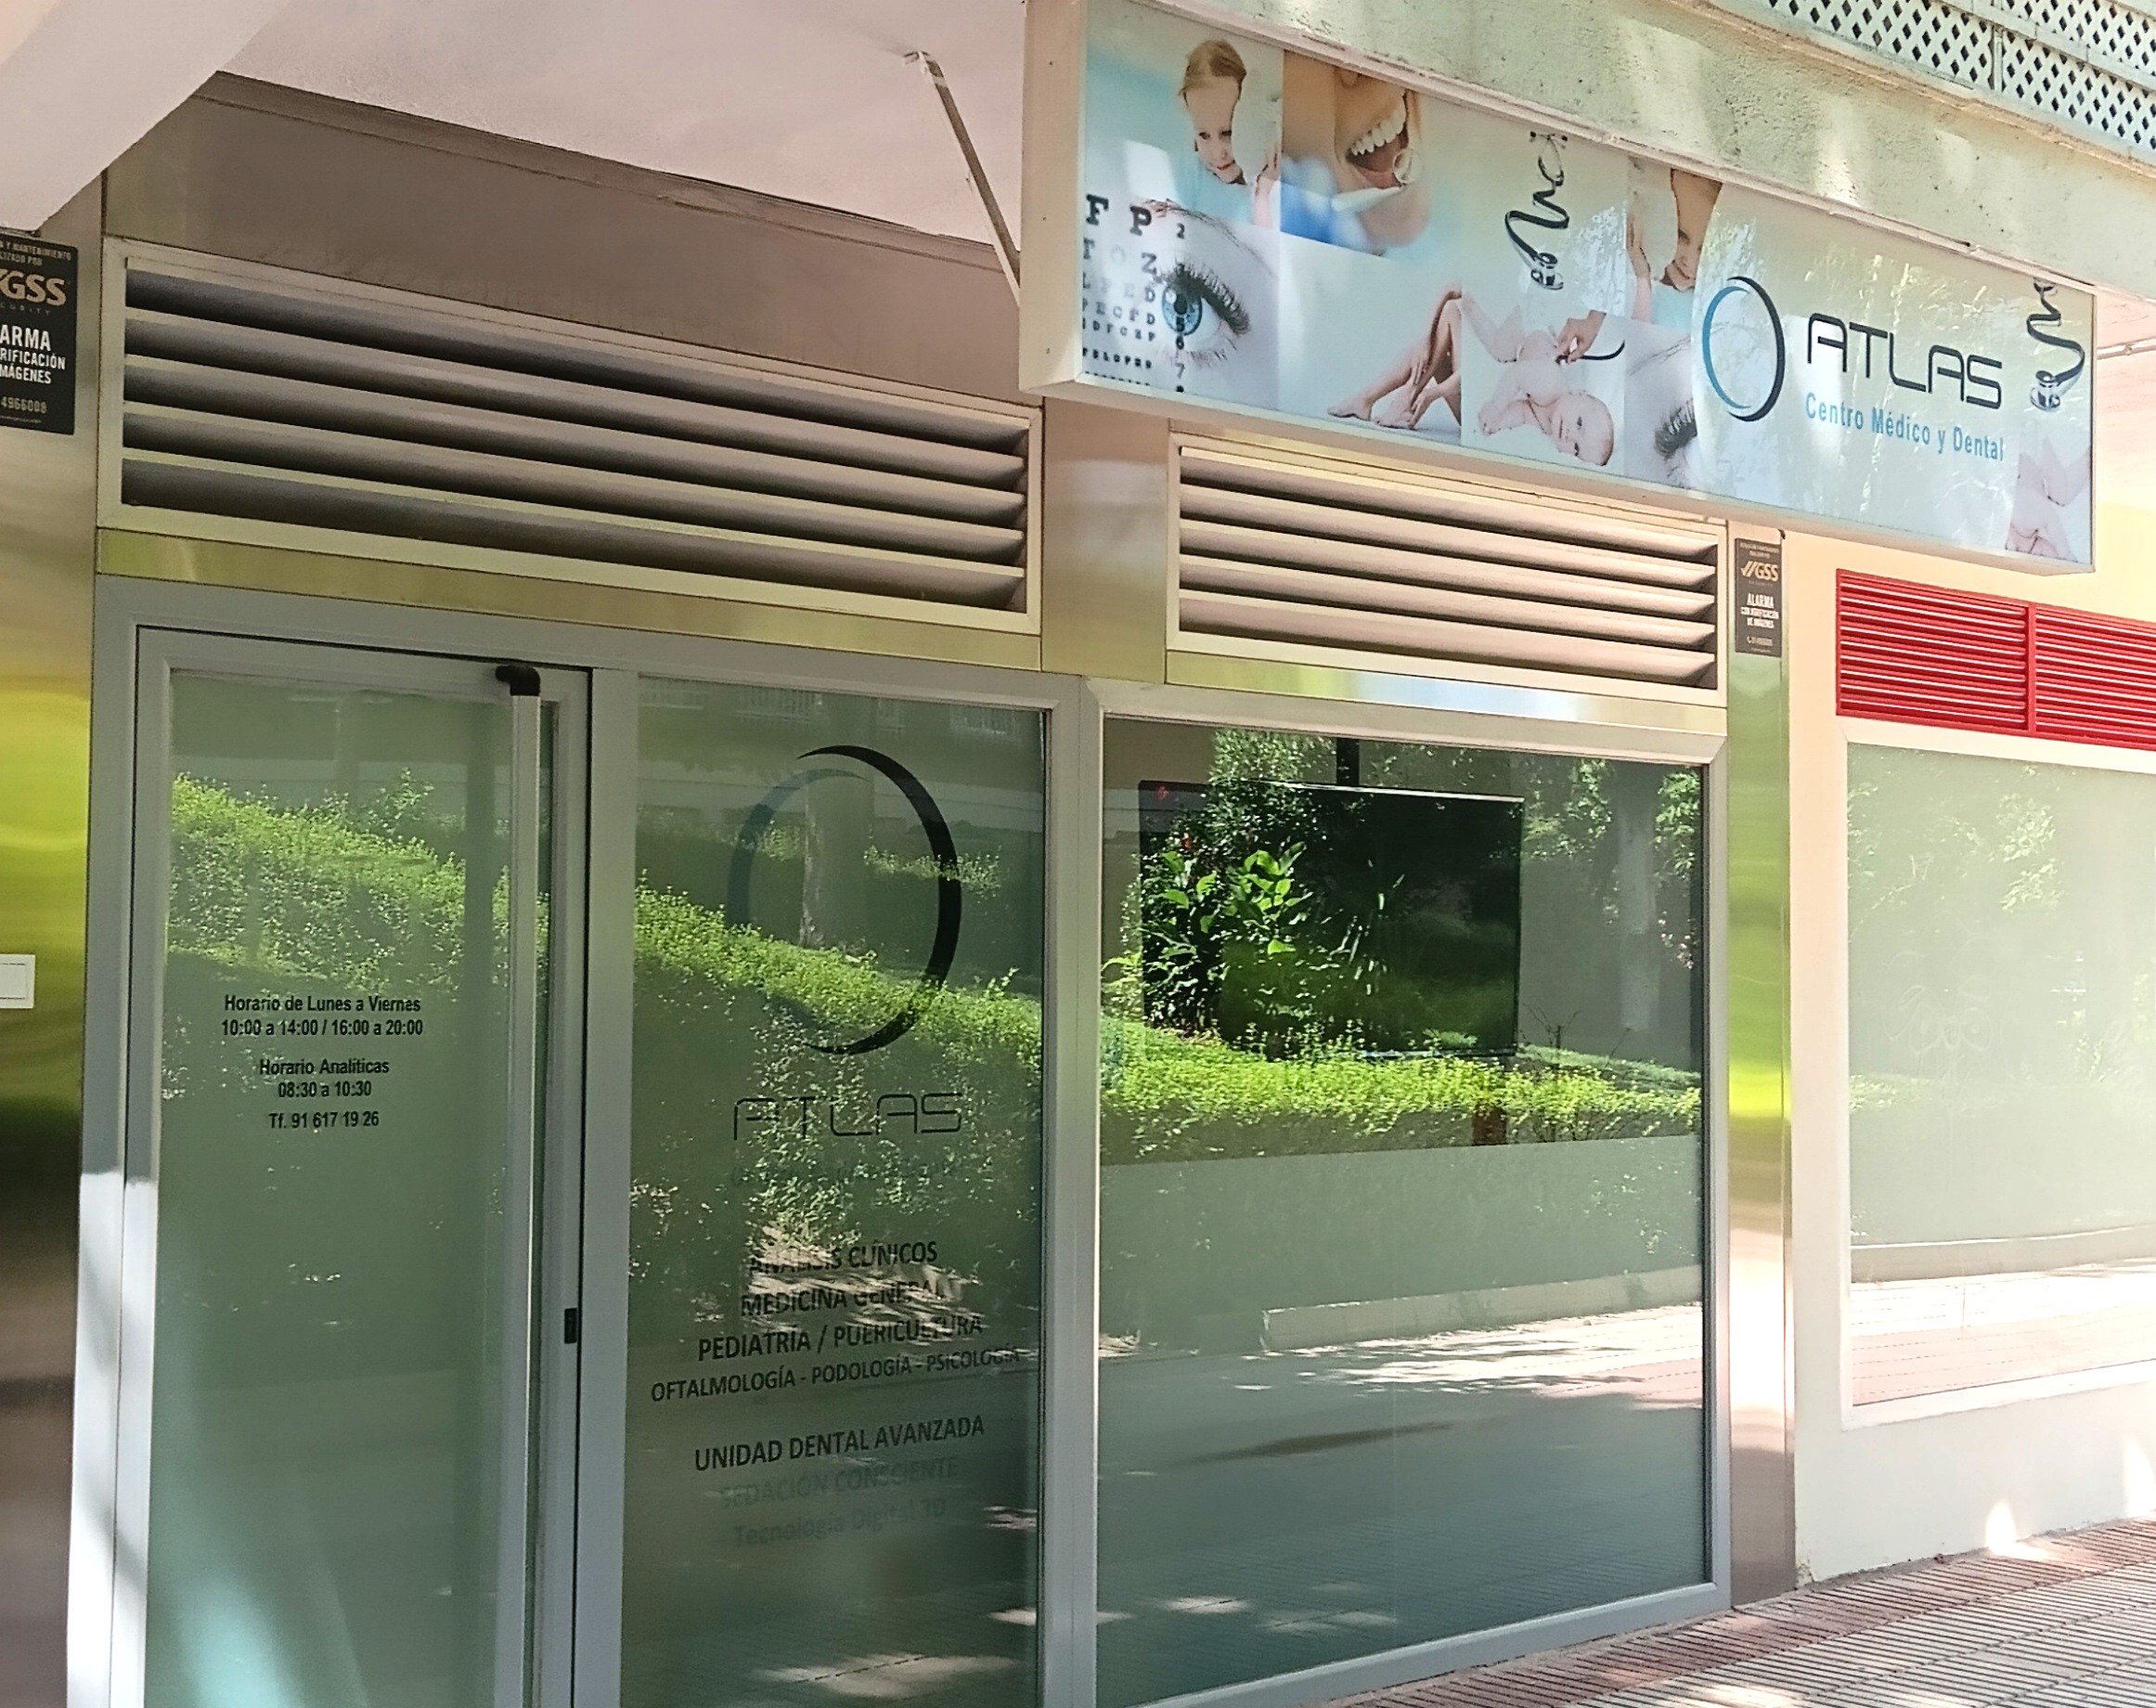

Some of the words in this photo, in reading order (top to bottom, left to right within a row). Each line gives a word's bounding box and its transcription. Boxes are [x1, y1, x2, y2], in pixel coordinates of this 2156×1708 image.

[1806, 312, 2003, 409] ATLAS
[1805, 391, 1864, 431] Centro
[1871, 407, 1931, 446] Médico
[1937, 429, 1946, 454] y
[1953, 425, 2005, 461] Dental
[225, 994, 279, 1012] Horario
[285, 995, 303, 1012] de
[308, 995, 352, 1012] Lunes
[356, 999, 364, 1012] a
[368, 995, 421, 1012] Viernes
[222, 1019, 262, 1036] 10:00
[265, 1024, 275, 1036] a
[280, 1019, 318, 1036] 14:00
[332, 1019, 369, 1036] 16:00
[373, 1023, 381, 1036] a
[385, 1019, 423, 1036] 20:00
[260, 1058, 315, 1075] Horario
[278, 1081, 317, 1098] 08:30
[321, 1084, 329, 1097] a
[334, 1080, 372, 1097] 10:30
[269, 1113, 287, 1129] Tf.
[291, 1112, 307, 1129] 91
[313, 1112, 338, 1128] 617
[342, 1111, 358, 1127] 19
[363, 1111, 380, 1127] 26
[732, 1092, 962, 1141] ATLAS
[742, 1287, 847, 1316] MEDICINA
[651, 1365, 796, 1402] OFTALMOLOGÍA
[695, 1439, 782, 1471] UNIDAD
[789, 1429, 870, 1460] DENTAL
[873, 1414, 985, 1449] AVANZADA
